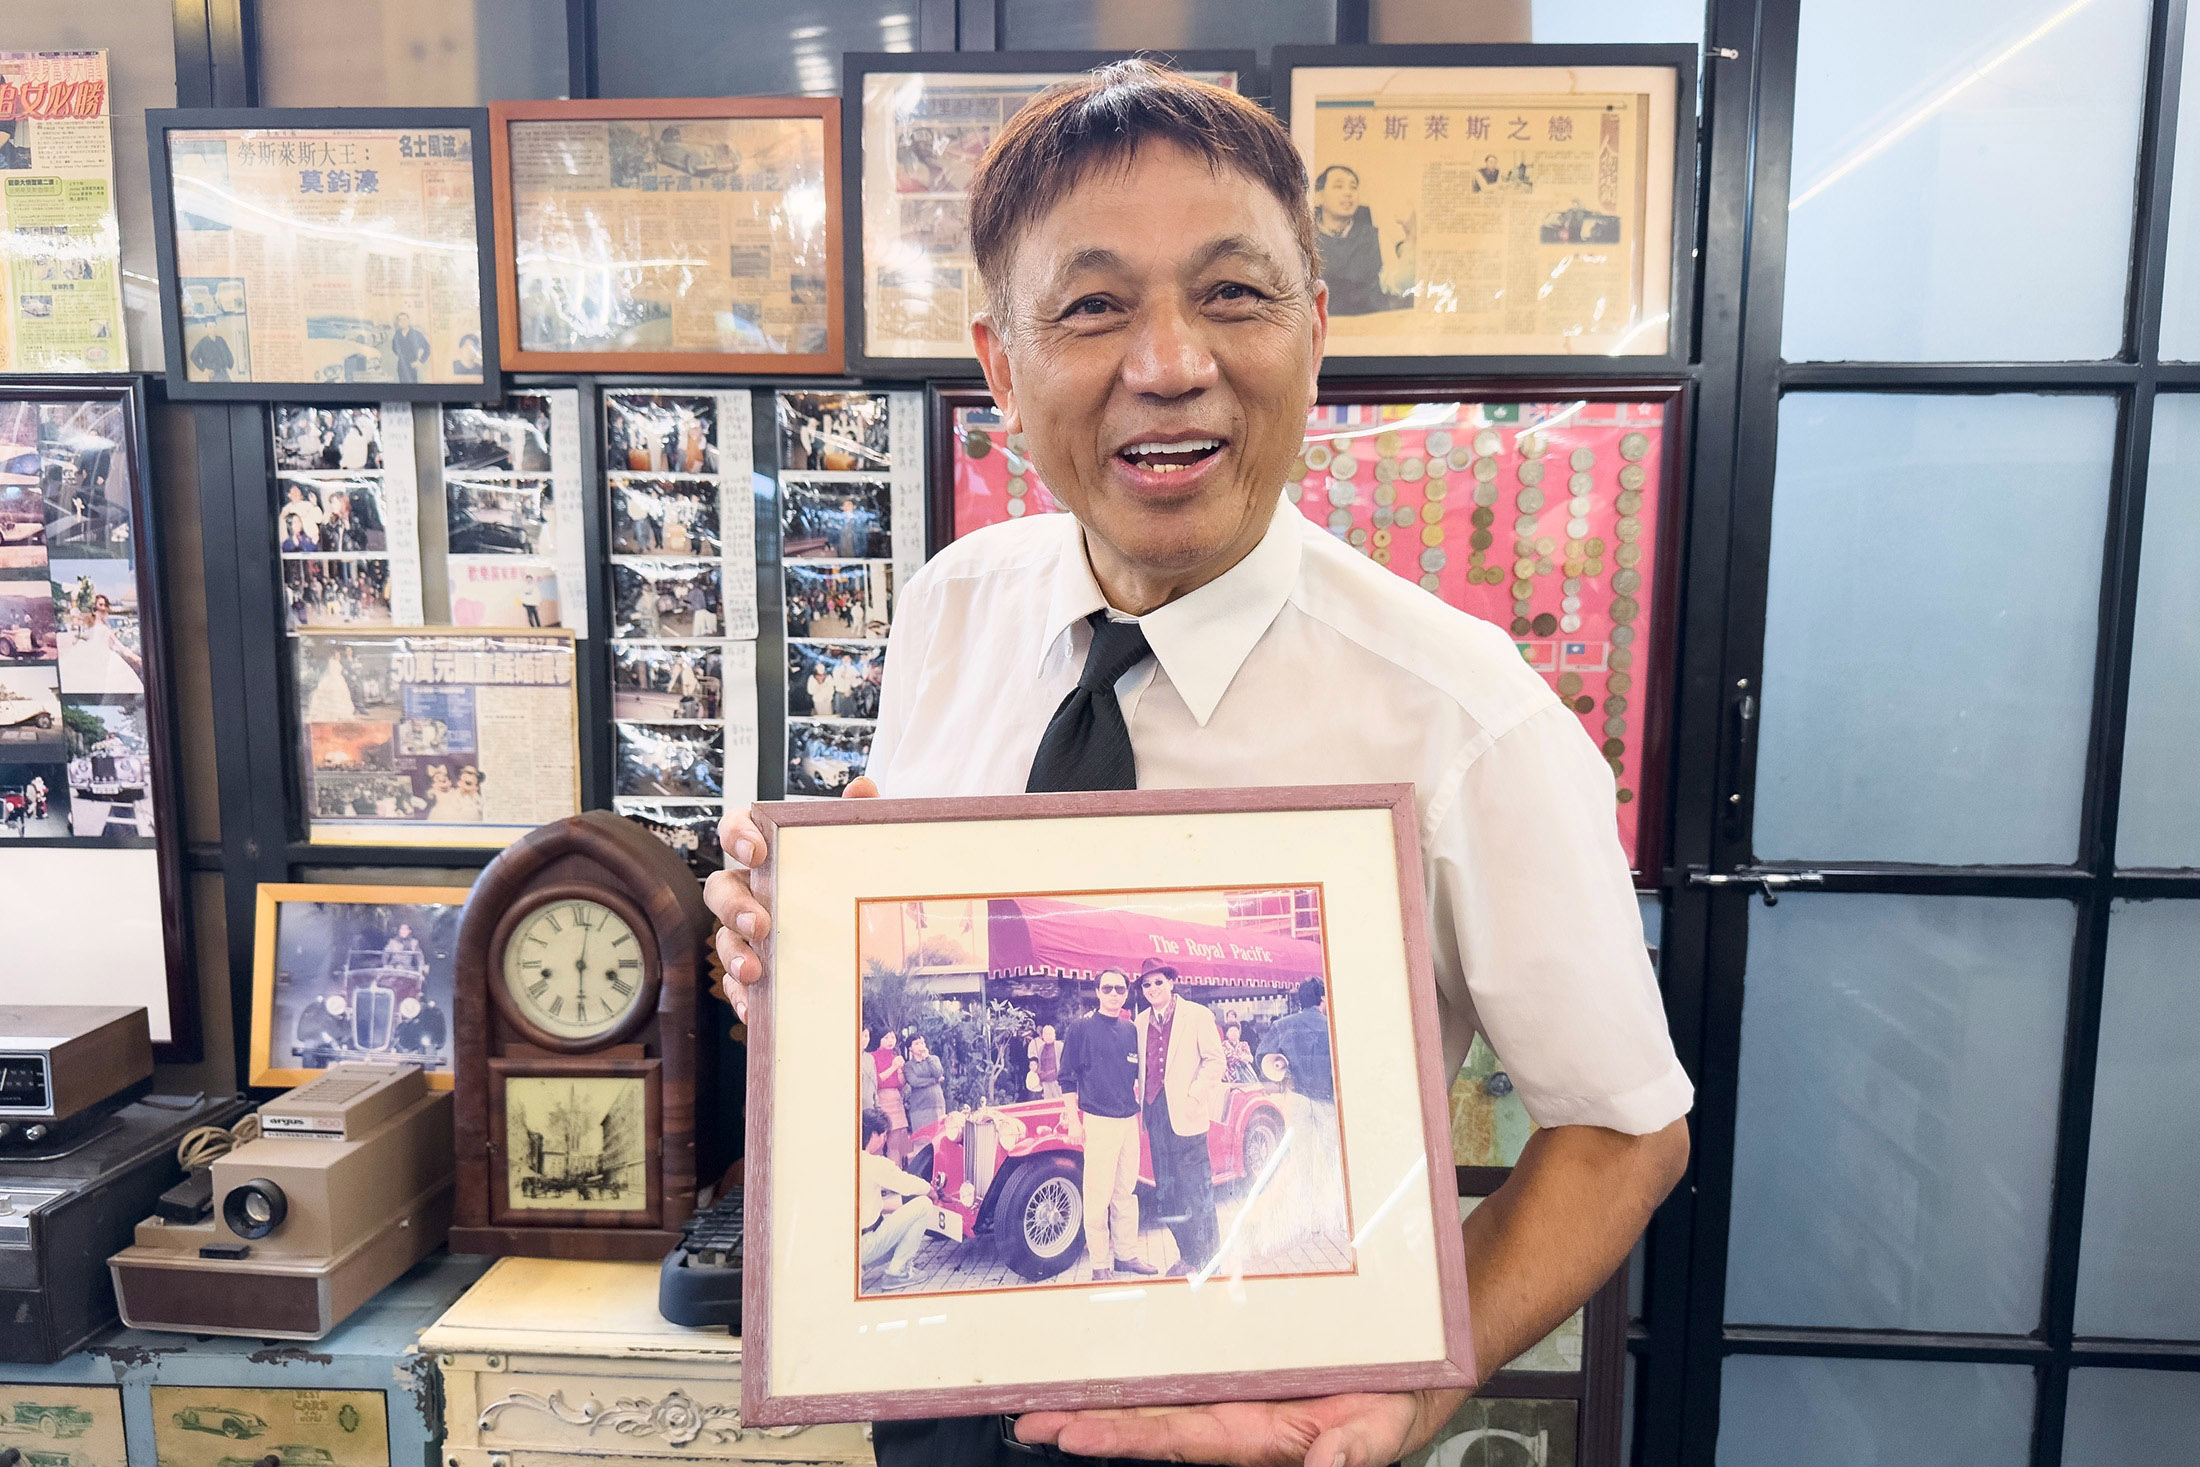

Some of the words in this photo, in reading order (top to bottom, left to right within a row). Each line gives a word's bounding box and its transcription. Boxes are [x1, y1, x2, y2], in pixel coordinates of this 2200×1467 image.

[1342, 115, 1573, 141] 勞斯萊斯之戀
[1149, 934, 1179, 954] The
[1184, 938, 1225, 960] Royal
[1229, 943, 1273, 962] Pacific
[270, 1118, 304, 1126] argus
[292, 1400, 329, 1411] CARS
